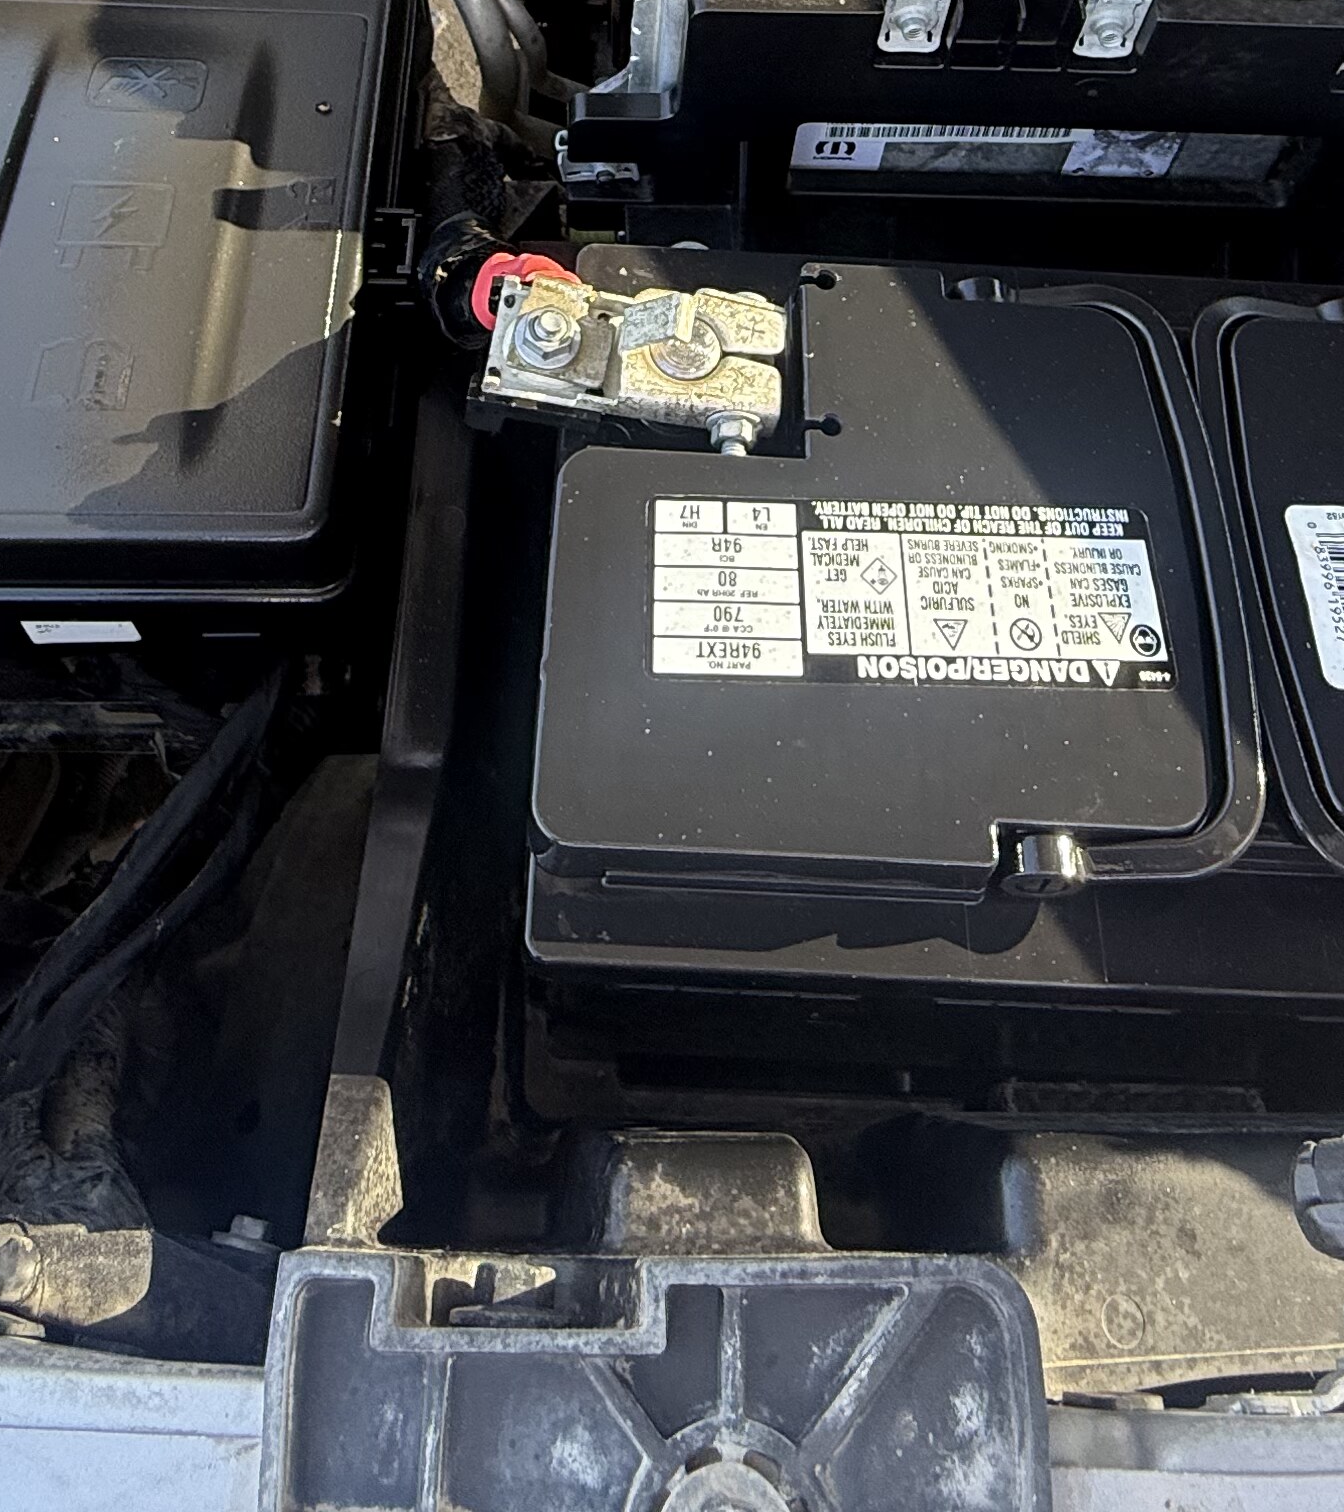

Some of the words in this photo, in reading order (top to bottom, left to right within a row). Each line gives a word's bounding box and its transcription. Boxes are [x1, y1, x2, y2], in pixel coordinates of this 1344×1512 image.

[680, 505, 700, 519] H7
[753, 507, 770, 522] L4
[811, 501, 869, 516] BATTERY.
[872, 503, 906, 517] OPEN
[909, 504, 934, 517] NOT
[937, 505, 956, 518] DO
[958, 505, 981, 519] TIP.
[984, 505, 1009, 520] NOT
[1012, 506, 1031, 520] DO
[1033, 506, 1129, 523] INSTRUCTIONS.
[819, 515, 844, 530] ALL
[846, 517, 881, 530] READ
[884, 518, 951, 532] CHILDREN.
[954, 519, 971, 533] OF
[973, 519, 1016, 534] REACH
[1018, 521, 1042, 534] THE
[1045, 522, 1061, 534] OF
[1065, 523, 1089, 535] OUT
[1092, 523, 1124, 536] KEEP
[712, 538, 742, 553] 94R
[808, 537, 837, 550] FAST.
[842, 539, 868, 552] HELP
[907, 539, 940, 551] BURNS
[944, 540, 978, 551] SEVERE
[810, 553, 860, 566] MEDICAL
[909, 553, 921, 564] OR
[924, 553, 977, 566] BLINDNESS
[1070, 548, 1106, 559] INJURY.
[1108, 549, 1122, 559] OR
[919, 567, 948, 578] CAUSE
[951, 568, 971, 580] CAN
[1054, 562, 1107, 575] BLINDNESS
[1109, 563, 1141, 575] CAUSE
[1314, 545, 1334, 590] 83996
[718, 571, 737, 587] 80
[826, 569, 847, 582] GET
[933, 581, 958, 594] ACID
[1070, 578, 1089, 589] CAN
[1093, 578, 1128, 592] GASES
[713, 589, 735, 597] 20HR
[817, 599, 860, 613] WATER.
[865, 600, 893, 614] WITH
[921, 596, 975, 611] SULFURIC
[1014, 594, 1029, 608] NO
[1070, 593, 1131, 608] EXPLOSIVE
[714, 606, 743, 622] 790
[1065, 614, 1097, 627] EYES.
[817, 615, 894, 630] IMMEDIATELY
[828, 631, 856, 646] EYES
[860, 632, 896, 647] FLUSH
[1061, 631, 1101, 645] SHIELD
[696, 641, 761, 659] 94REXT
[727, 661, 751, 669] PART
[857, 656, 1090, 682] DANGER/POISON
